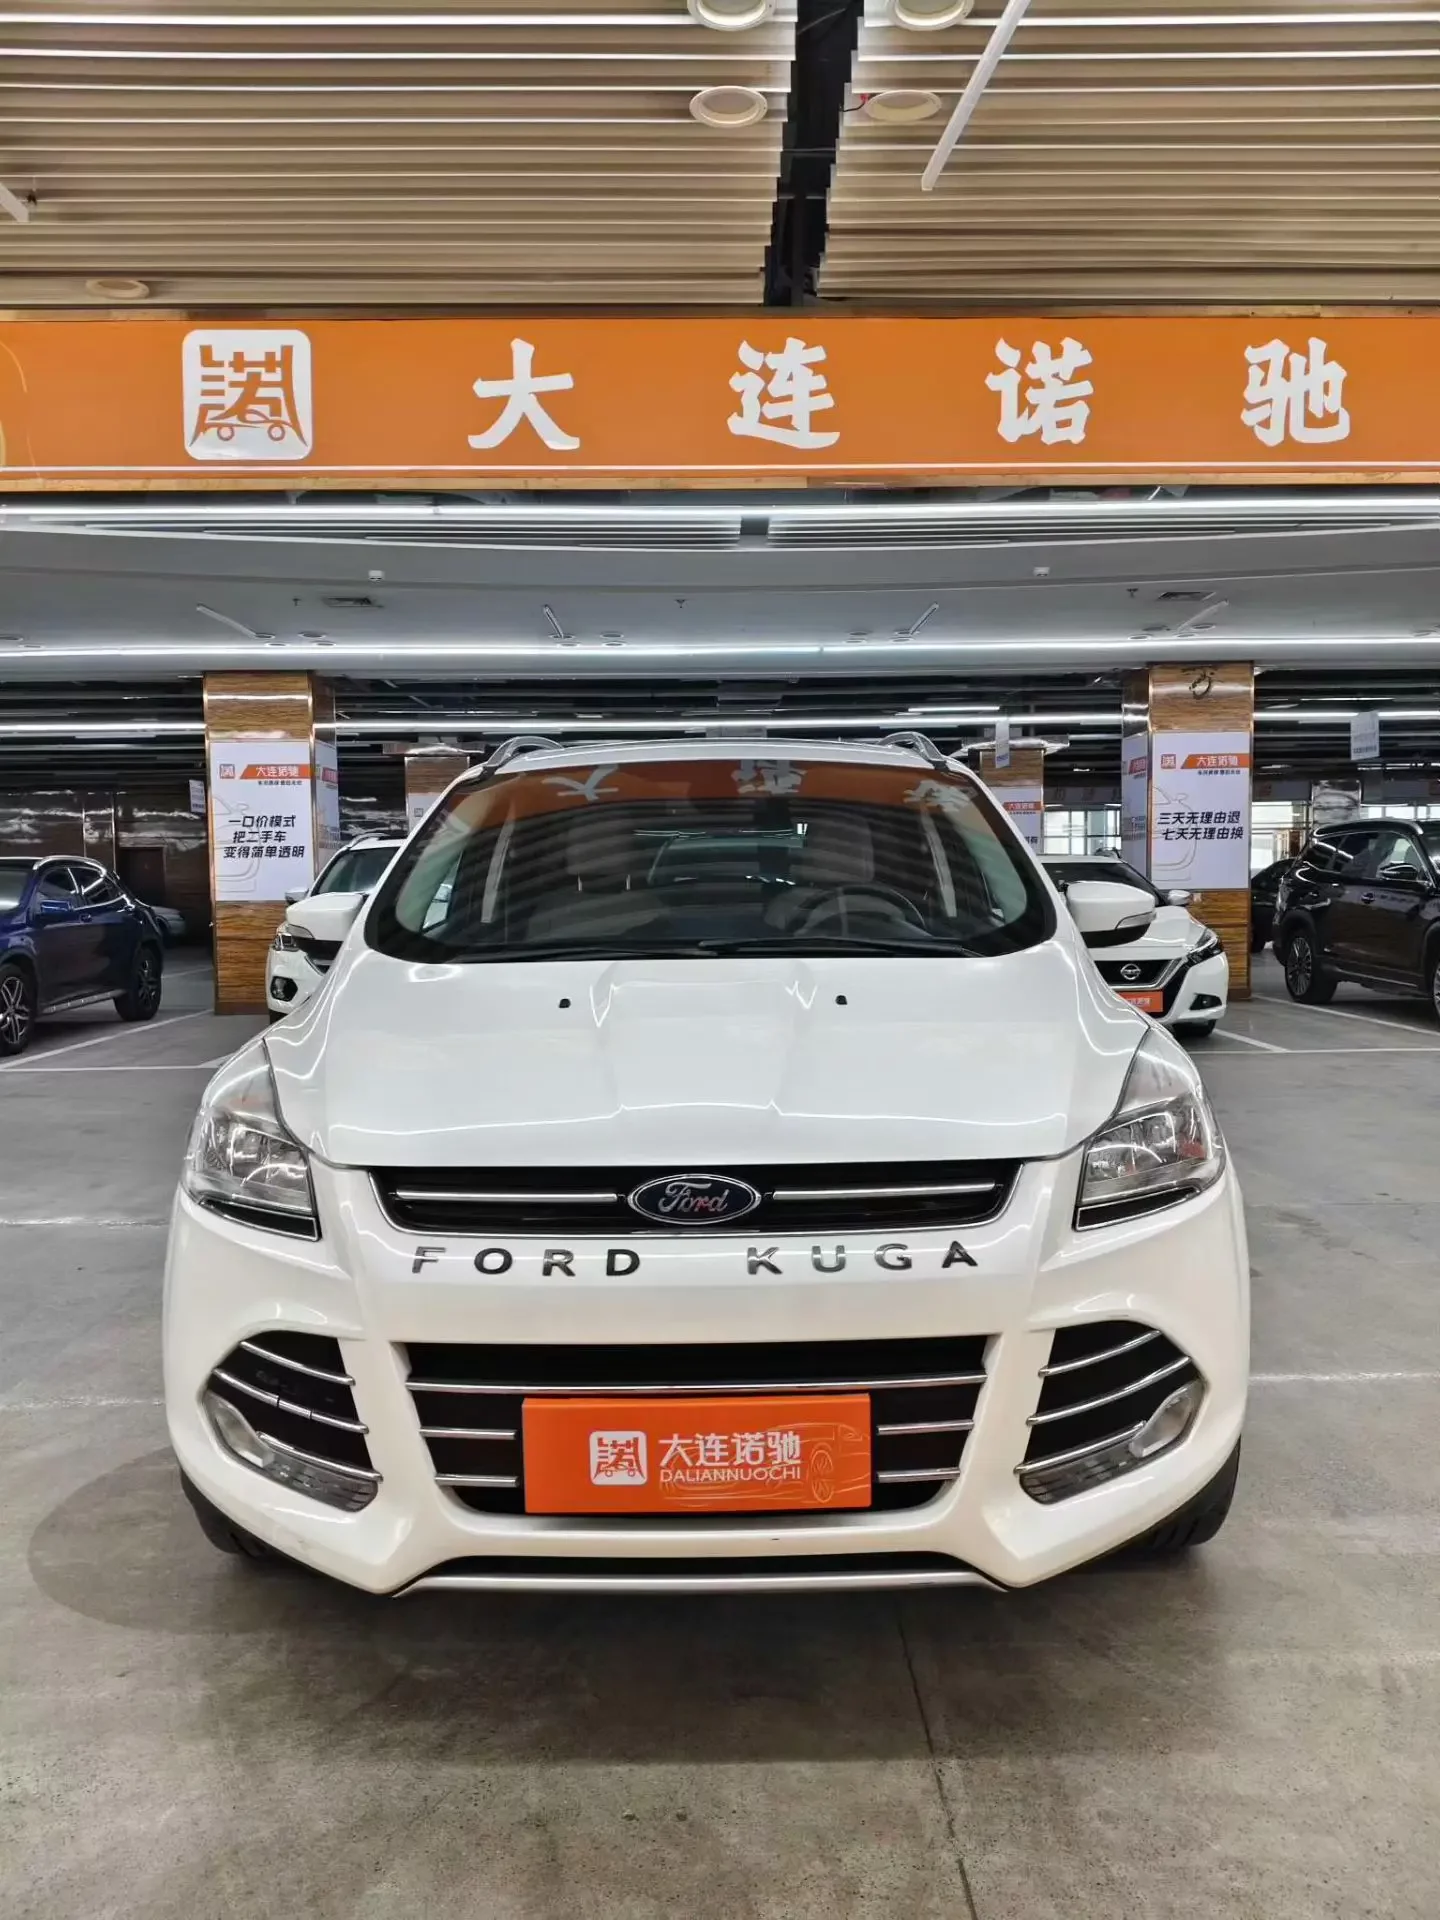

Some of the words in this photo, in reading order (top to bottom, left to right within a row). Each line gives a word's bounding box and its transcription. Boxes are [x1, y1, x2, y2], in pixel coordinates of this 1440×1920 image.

[467, 337, 1351, 450] 大连诺驰
[228, 814, 297, 828] 一口价模式
[1157, 810, 1241, 825] 三天无理由退
[232, 830, 288, 843] 把二手车
[1161, 826, 1244, 841] 七天无理由换
[223, 845, 305, 859] 变得简单透明
[657, 1182, 728, 1214] Ford
[411, 1246, 641, 1277] FORD
[746, 1240, 979, 1275] KUGA
[658, 1430, 801, 1467] 大连诺驰
[659, 1465, 801, 1483] DALIANNUOCHI
